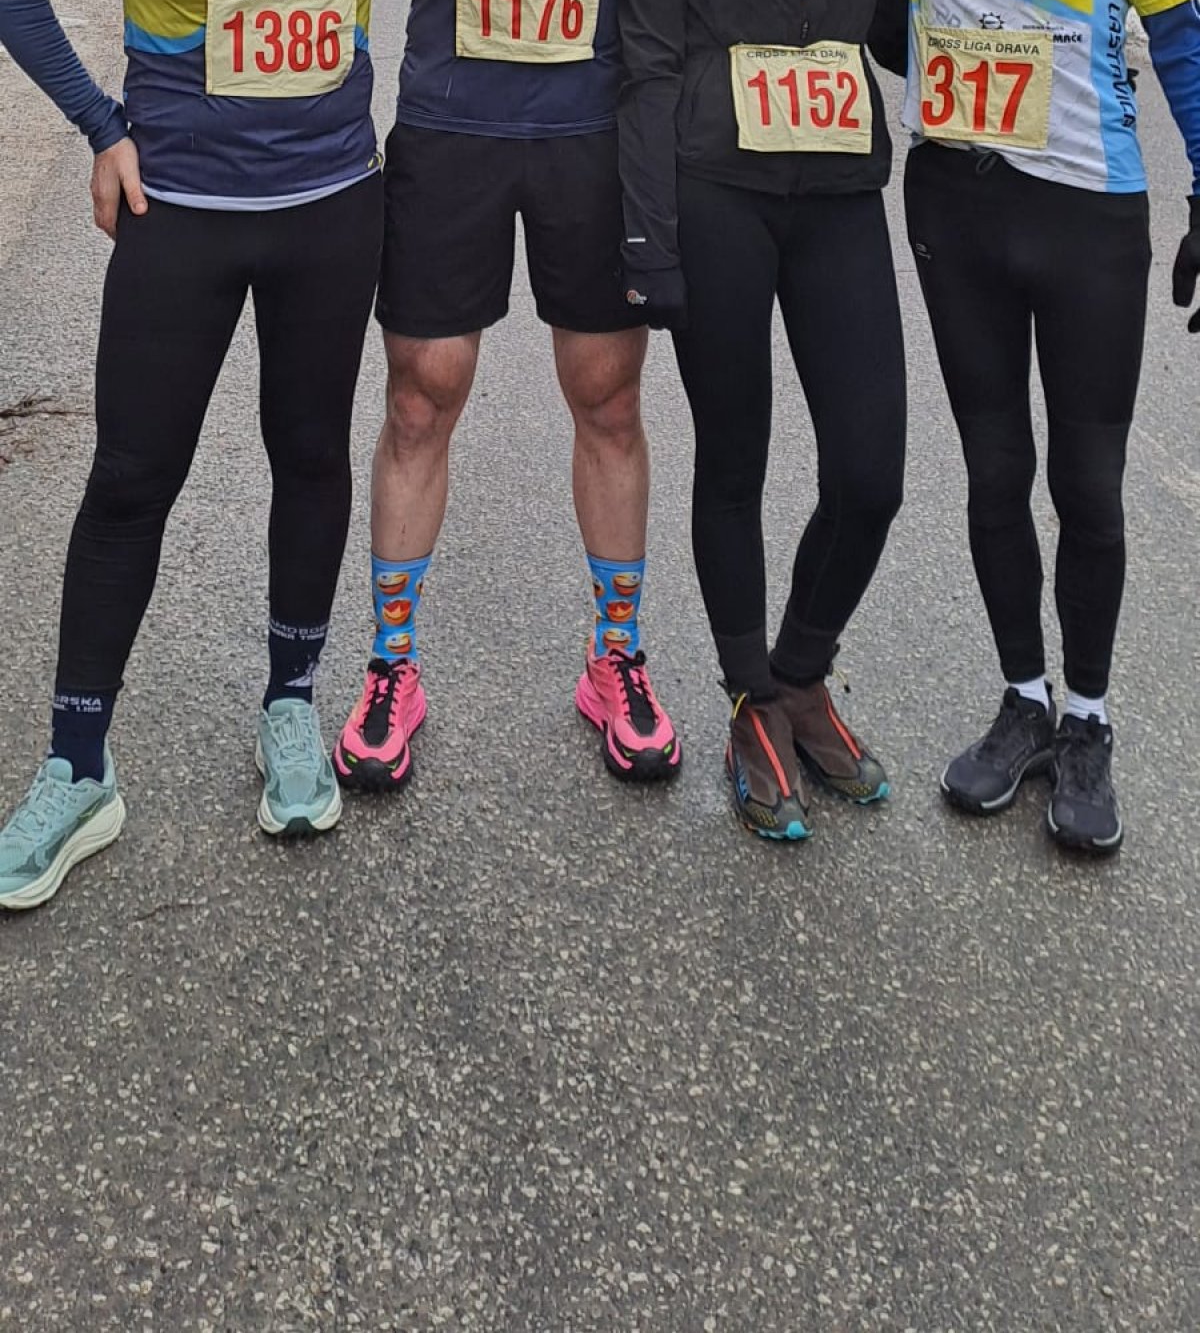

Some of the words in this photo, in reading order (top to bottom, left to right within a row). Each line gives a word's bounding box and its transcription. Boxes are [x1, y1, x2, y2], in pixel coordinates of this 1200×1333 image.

[223, 10, 342, 74] 1386
[964, 41, 992, 52] LIGA
[995, 43, 1040, 55] DRAVA
[1107, 3, 1136, 128] LASTAVICA
[747, 68, 860, 129] 1152
[922, 55, 1034, 133] 317
